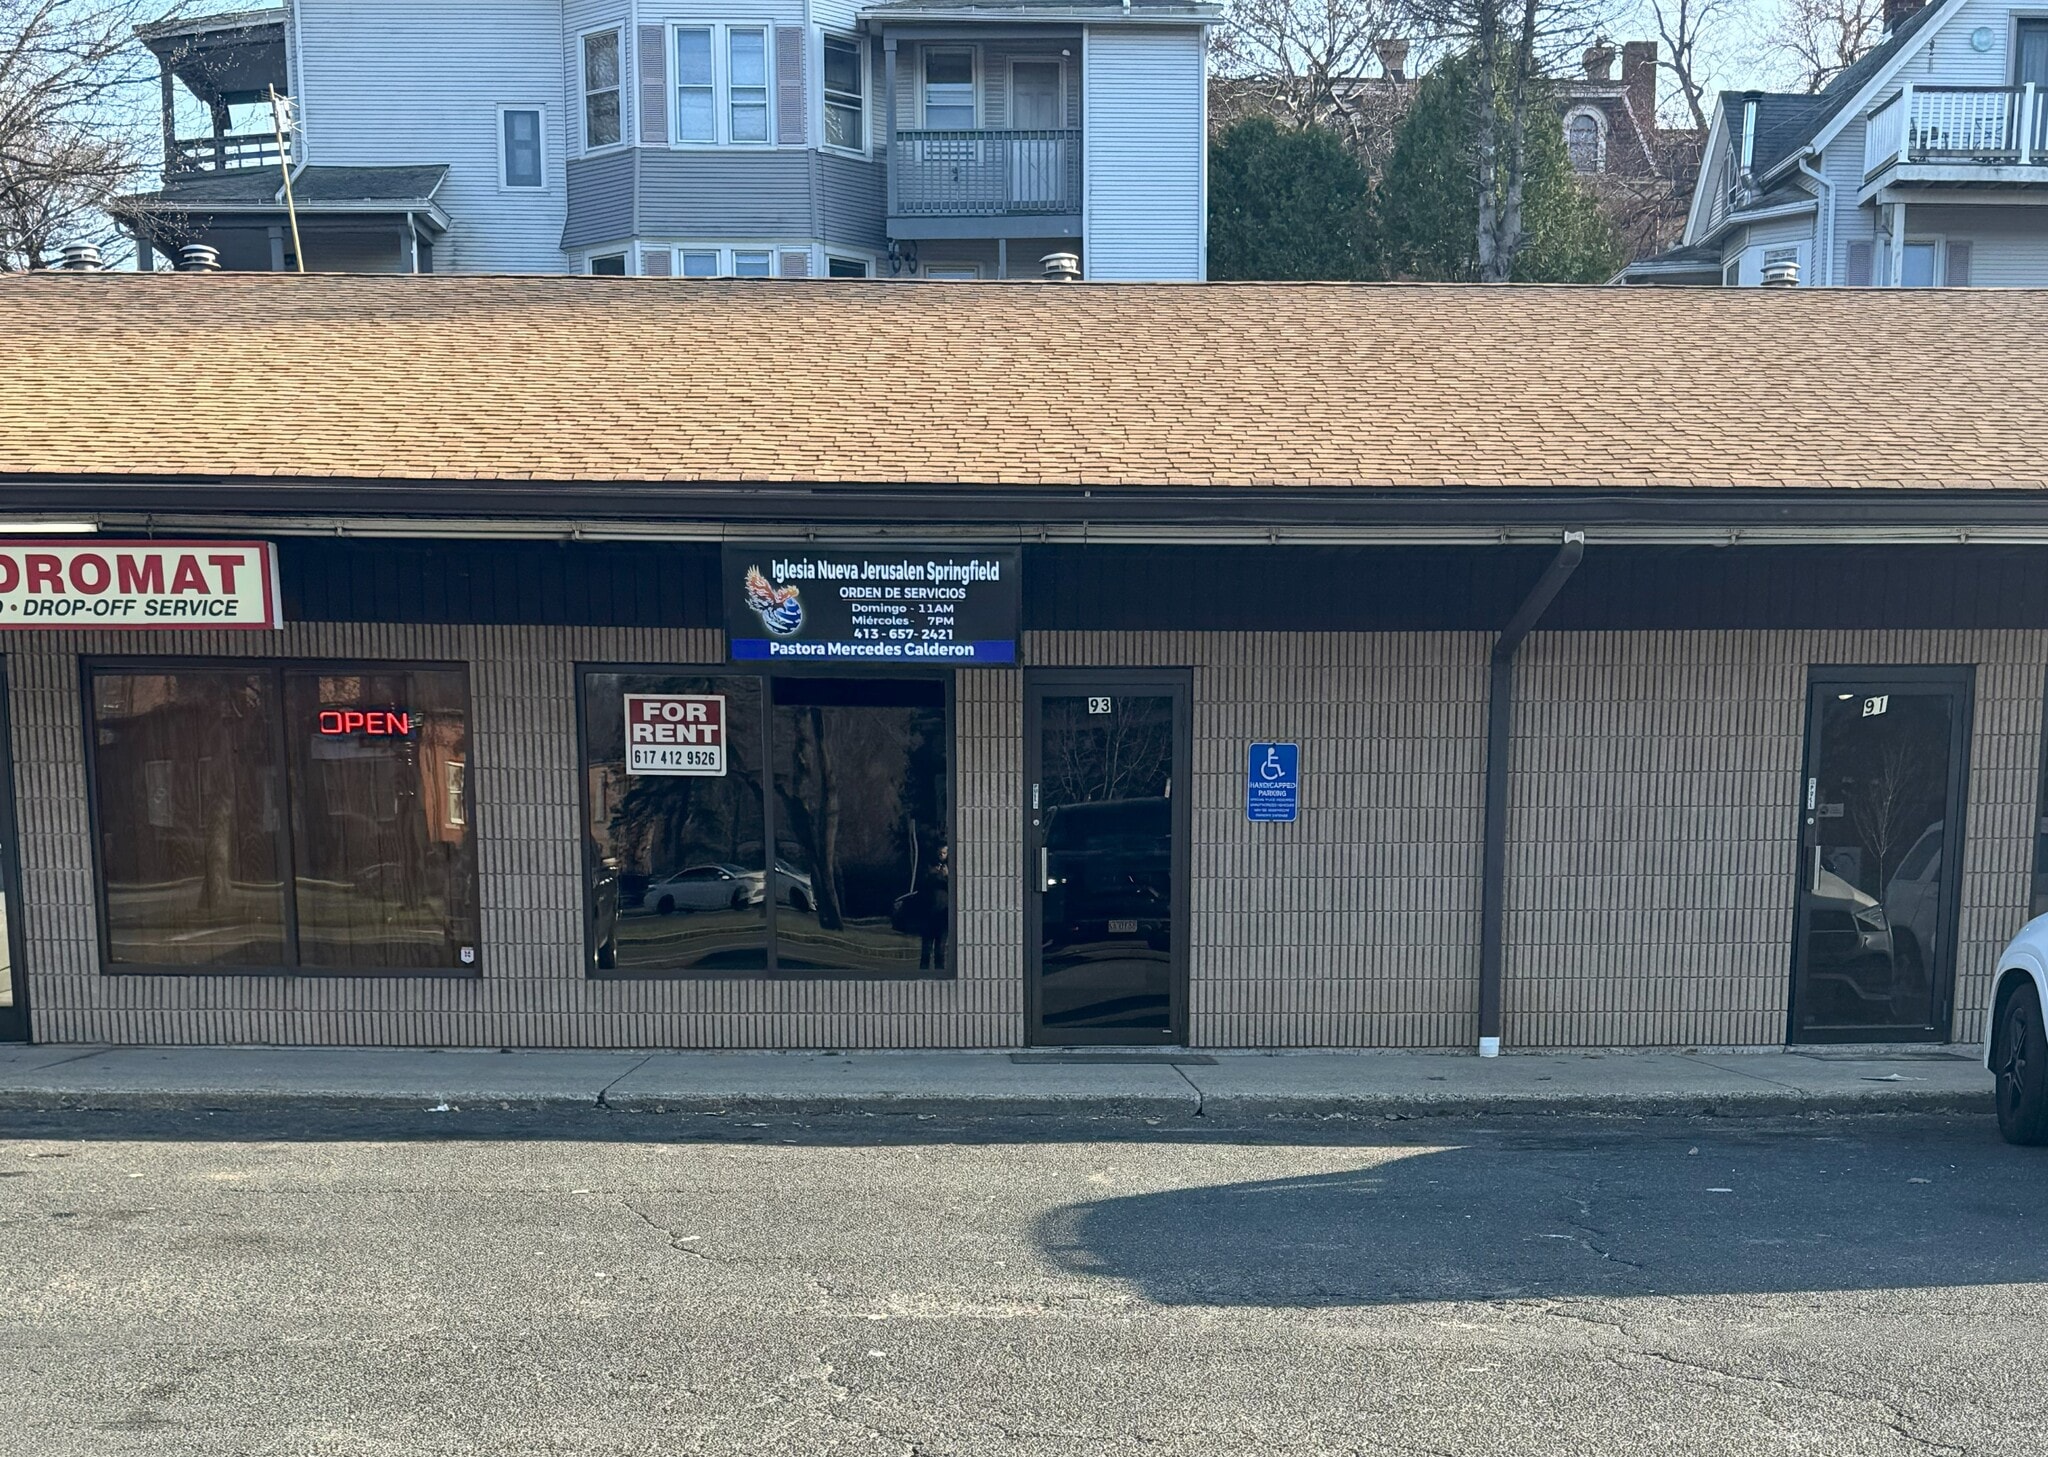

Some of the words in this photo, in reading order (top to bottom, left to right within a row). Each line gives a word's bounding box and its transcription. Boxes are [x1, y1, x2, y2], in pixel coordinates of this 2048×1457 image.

[772, 559, 815, 583] Iglesia
[818, 560, 858, 580] Nueva
[860, 560, 924, 581] Jerusalen
[927, 559, 1000, 584] Springfield
[840, 587, 882, 598] ORDEN
[885, 587, 901, 598] DE
[904, 587, 967, 599] SERVICIOS
[23, 599, 137, 616] DROP-OFF
[144, 599, 239, 617] SERVICE
[852, 603, 907, 614] Domingo
[919, 604, 954, 613] 11AM
[927, 616, 954, 625] 7PM
[770, 642, 826, 655] Pastora
[828, 642, 901, 656] Mercedes
[904, 643, 975, 657] Calderon
[642, 702, 707, 722] FOR
[1090, 698, 1110, 713] 93
[1865, 697, 1885, 714] 91
[319, 711, 409, 735] OPEN
[632, 723, 719, 743] RENT
[634, 750, 656, 764] 617
[660, 750, 682, 765] 412
[687, 751, 715, 766] 9526
